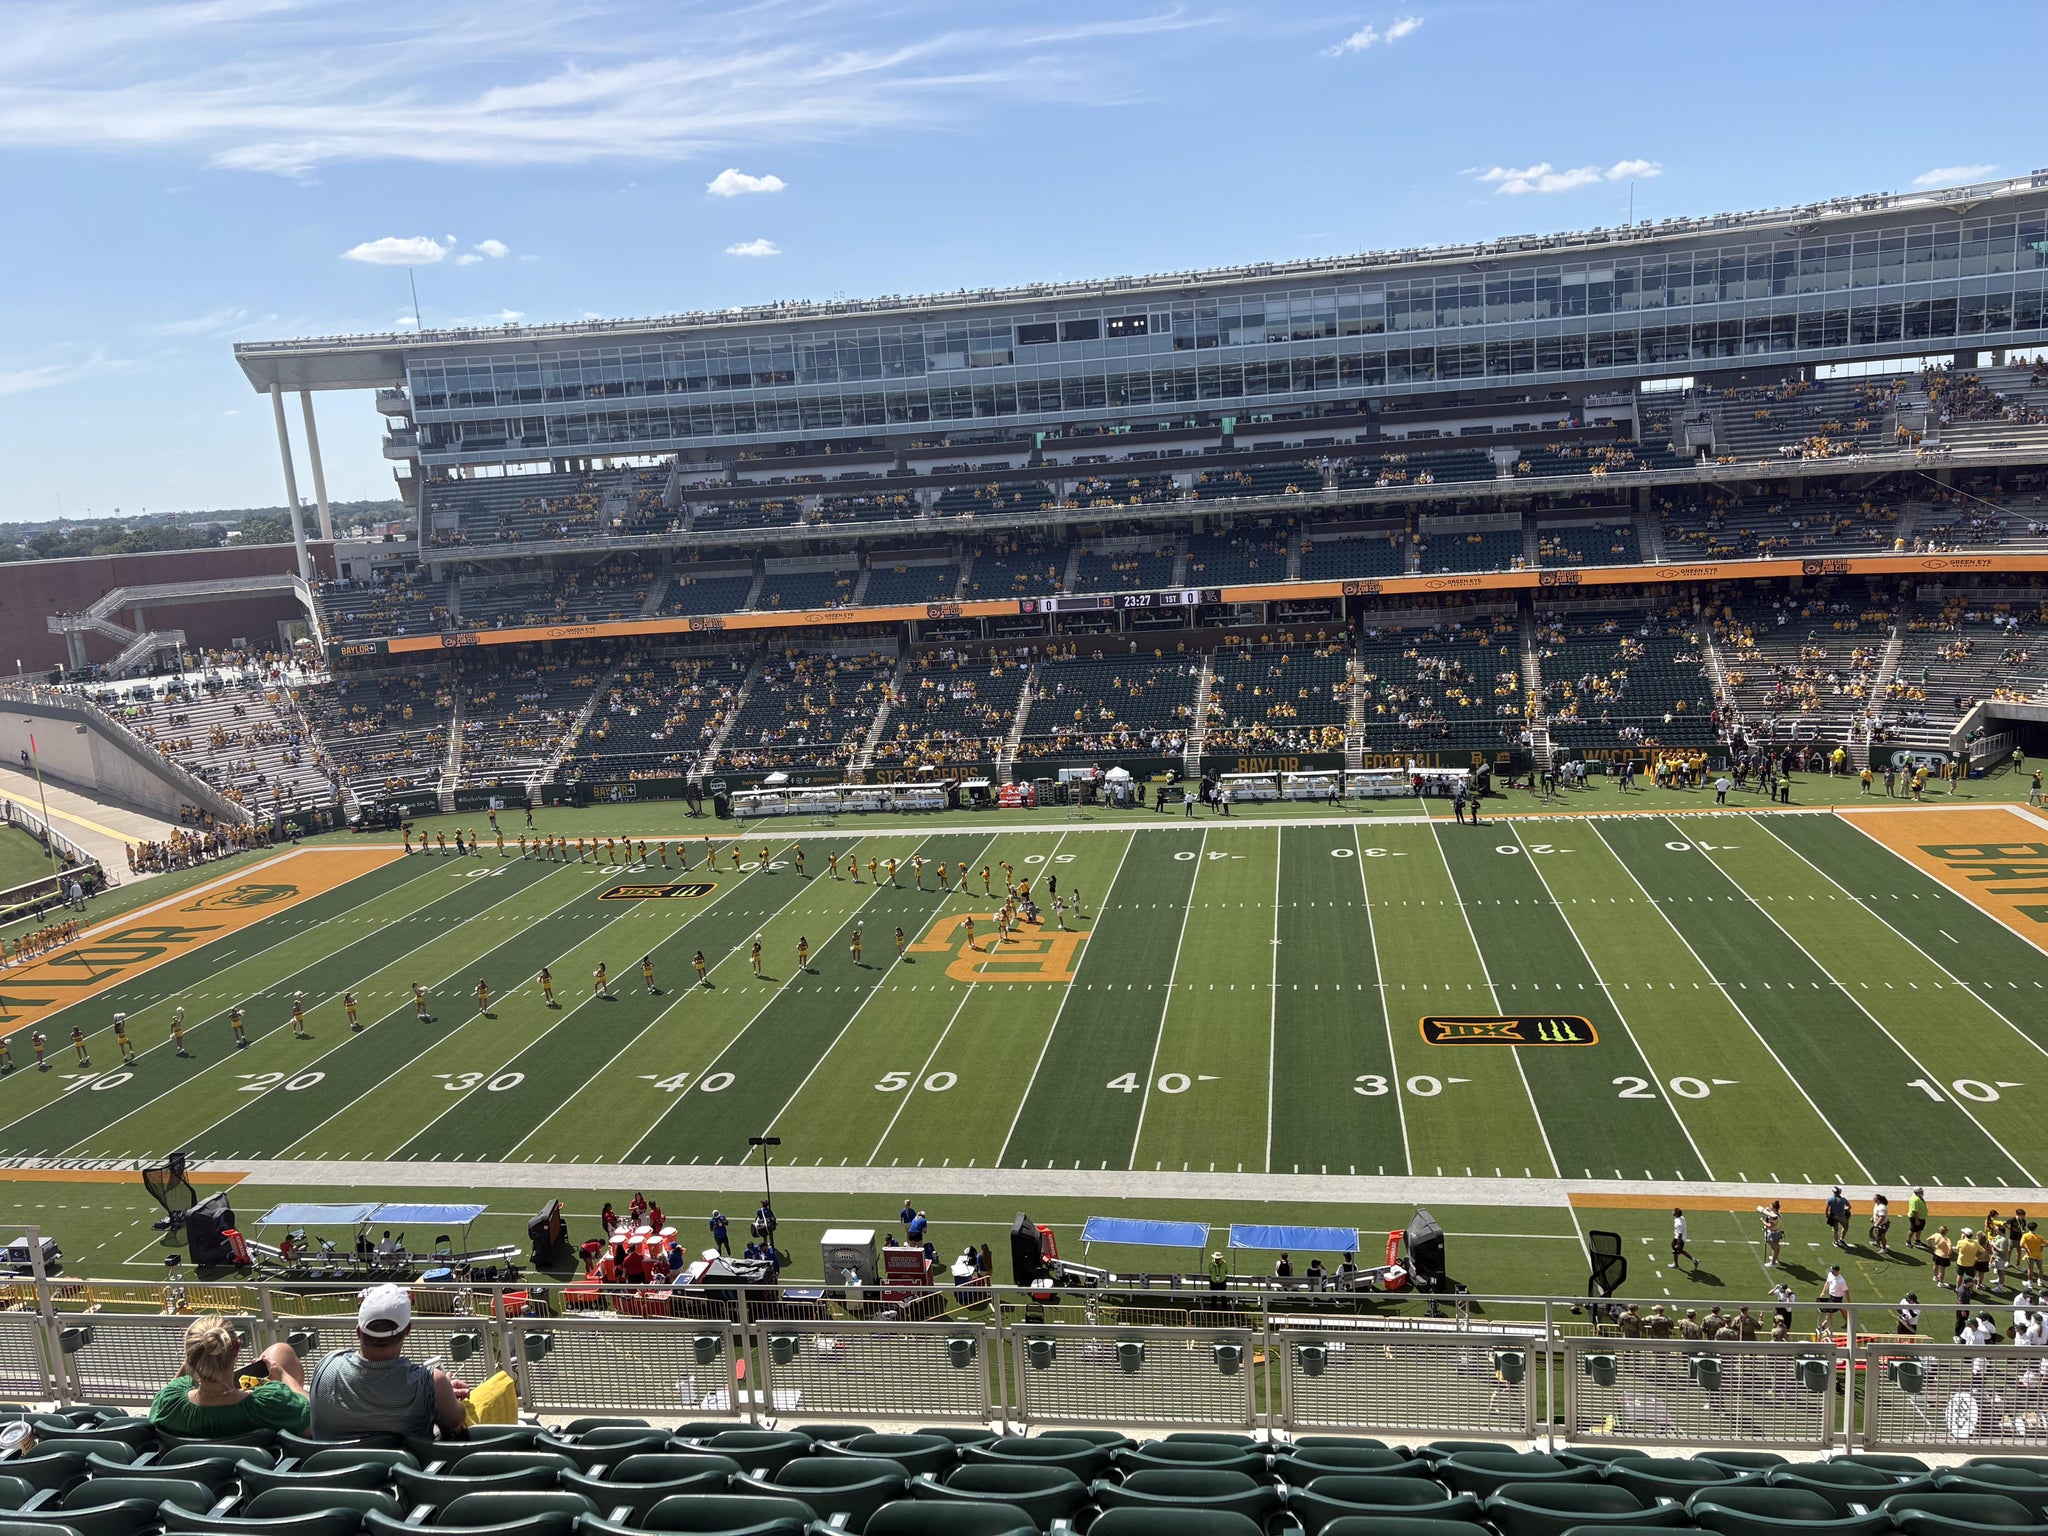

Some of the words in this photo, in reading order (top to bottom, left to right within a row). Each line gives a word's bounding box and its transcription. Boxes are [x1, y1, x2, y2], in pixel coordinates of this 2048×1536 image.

[1046, 600, 1052, 611] 0
[1124, 595, 1151, 607] 23:27
[1165, 595, 1177, 603] 1ST
[1188, 592, 1193, 603] 0
[932, 767, 978, 782] BEARS
[1237, 757, 1299, 773] BAYLOR
[1024, 854, 1077, 864] 50
[62, 1072, 134, 1091] 10
[236, 1071, 325, 1091] 20
[443, 1072, 525, 1092] 30
[653, 1072, 736, 1092] 40
[873, 1071, 958, 1092] 50
[1106, 1072, 1191, 1093] 40
[1351, 1075, 1443, 1097] 30
[1610, 1076, 1710, 1099] 20
[1905, 1078, 1999, 1102] 10
[29, 1158, 122, 1170] EDDIE
